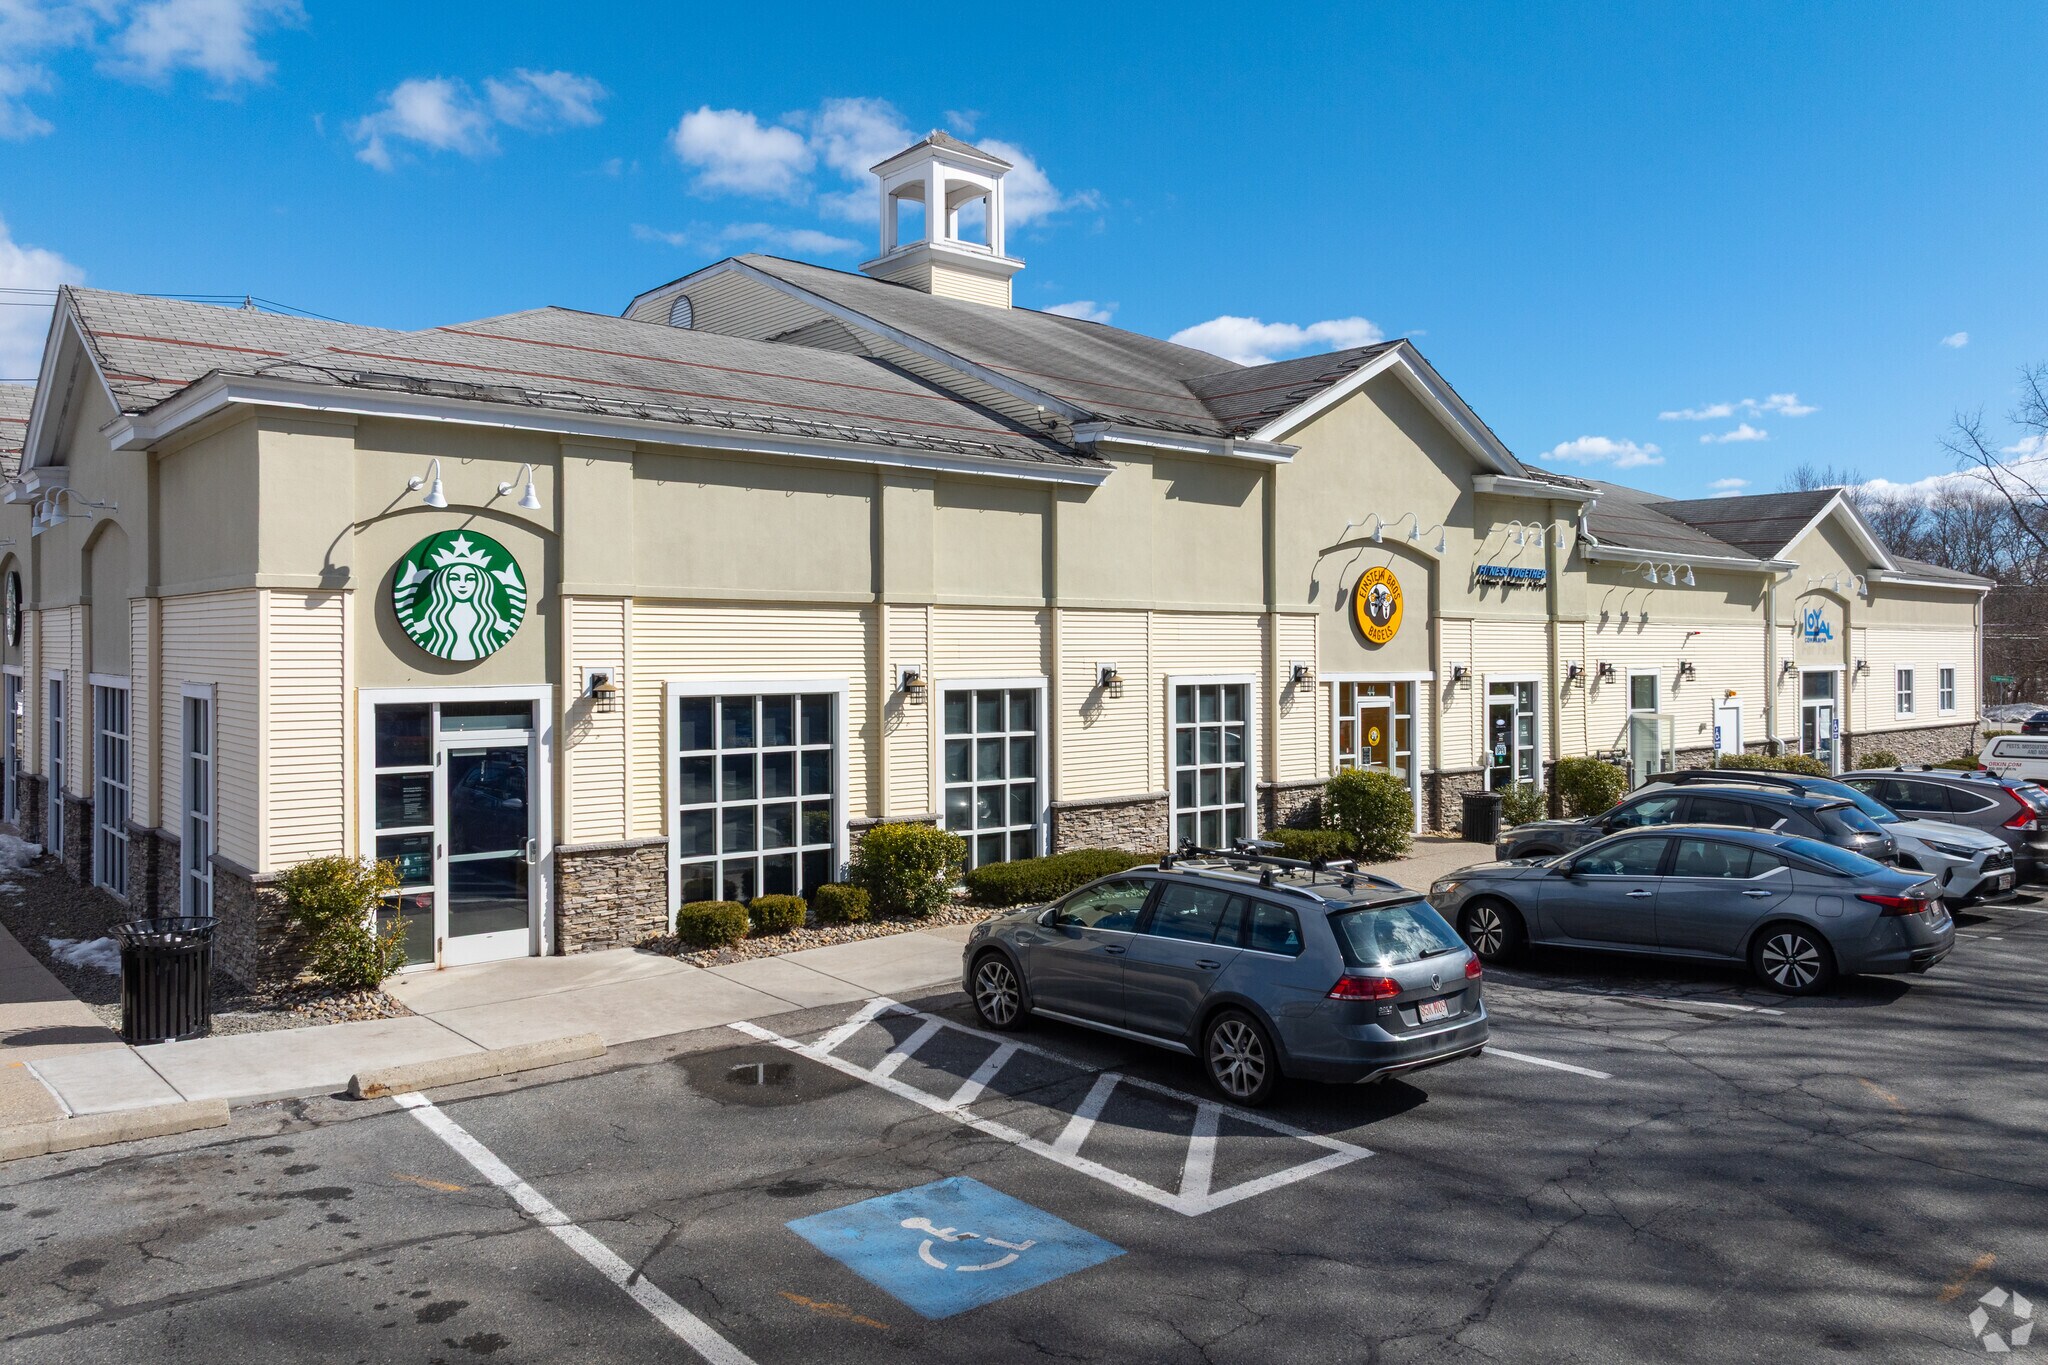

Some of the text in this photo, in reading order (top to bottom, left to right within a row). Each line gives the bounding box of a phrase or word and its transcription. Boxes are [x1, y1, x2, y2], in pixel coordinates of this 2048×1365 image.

[1478, 565, 1547, 579] FITNESS TOGETHER
[1359, 570, 1401, 601] EINSTEIN BROS
[1367, 625, 1393, 641] BAGELS
[1804, 608, 1834, 640] LOYAL
